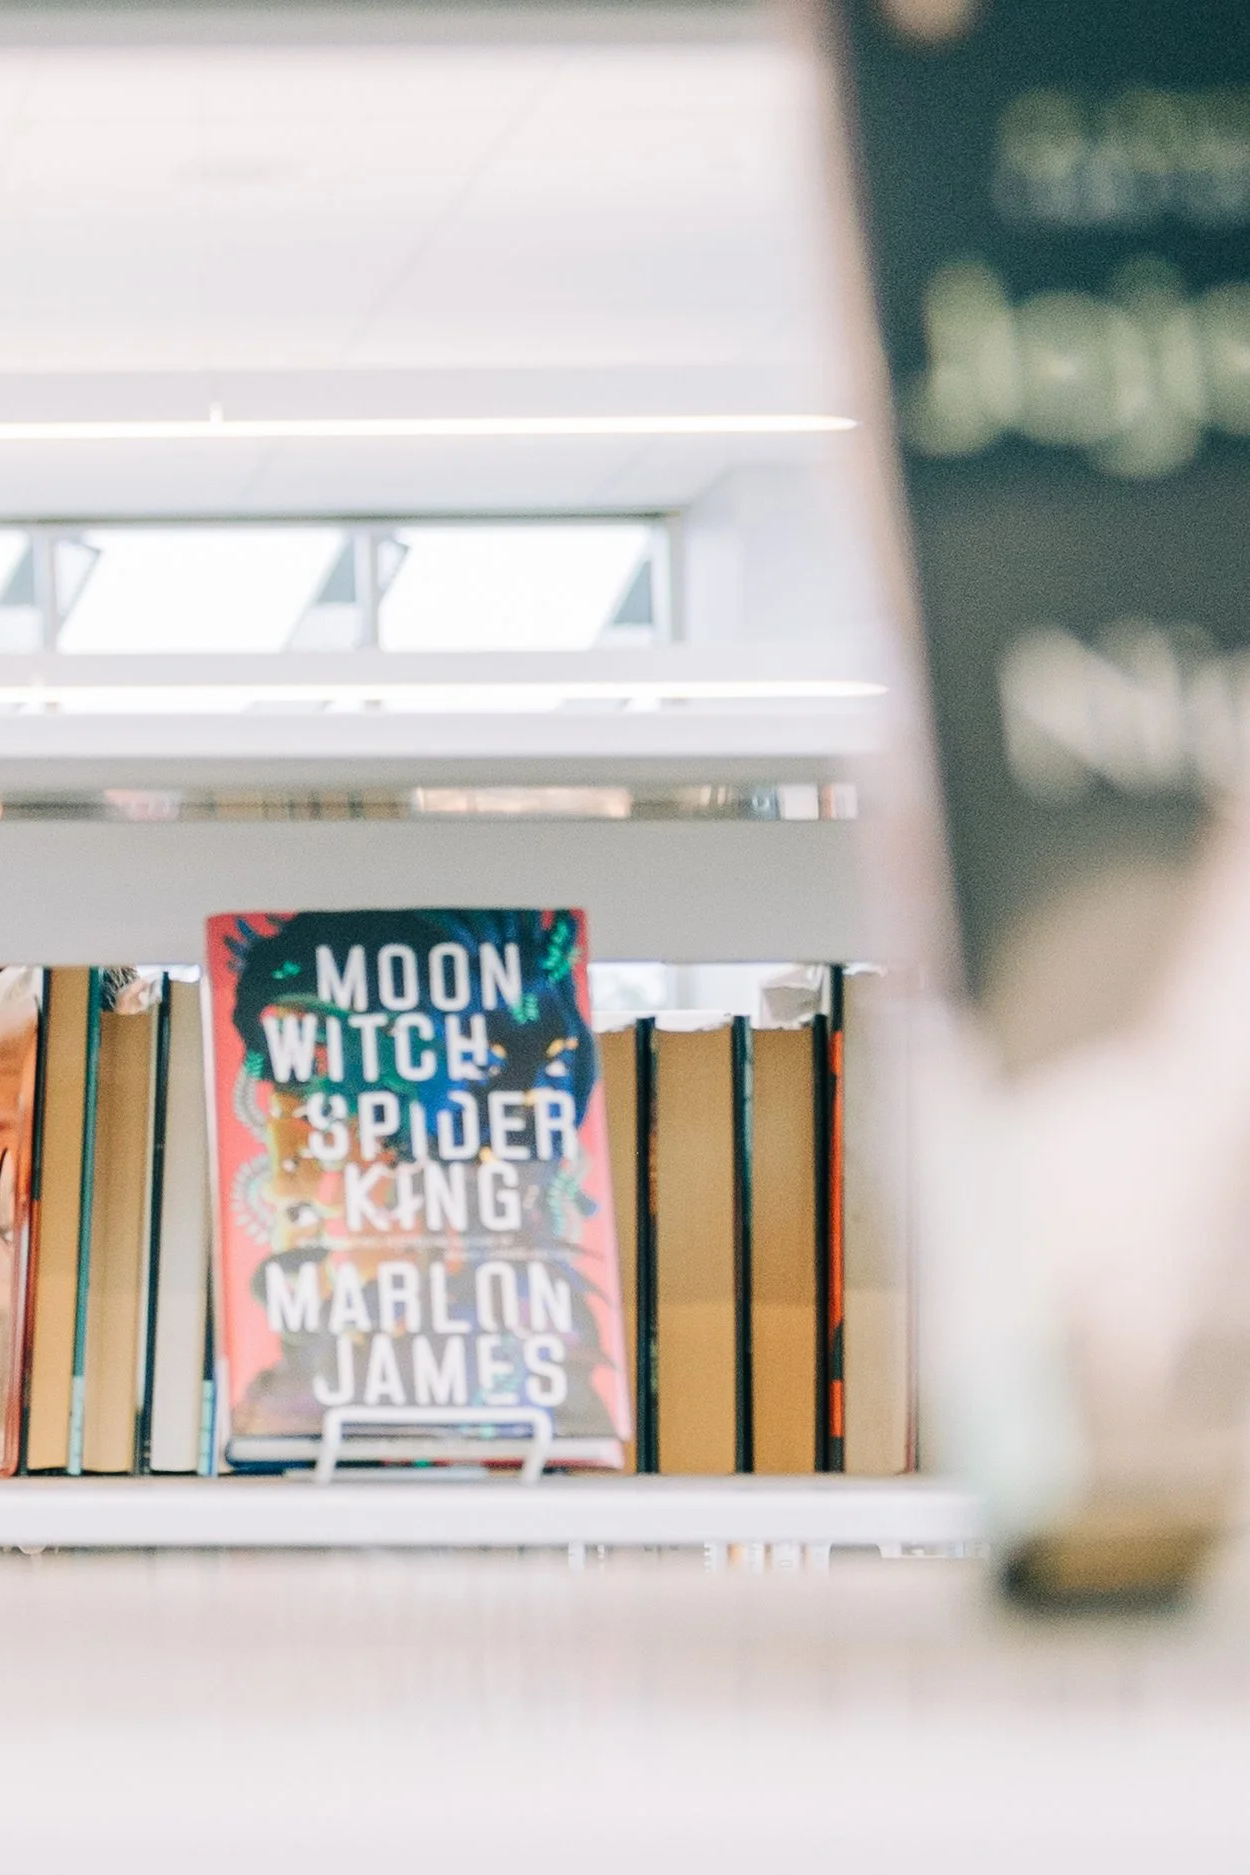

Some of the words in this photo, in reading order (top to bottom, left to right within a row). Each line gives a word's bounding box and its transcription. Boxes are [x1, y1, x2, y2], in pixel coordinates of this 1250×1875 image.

[315, 942, 522, 1012] MOON
[262, 1013, 489, 1083] WITCH
[306, 1091, 579, 1162] SPIDER
[344, 1162, 523, 1232] KING
[265, 1261, 573, 1334] MARLON
[313, 1334, 568, 1406] JAMES
